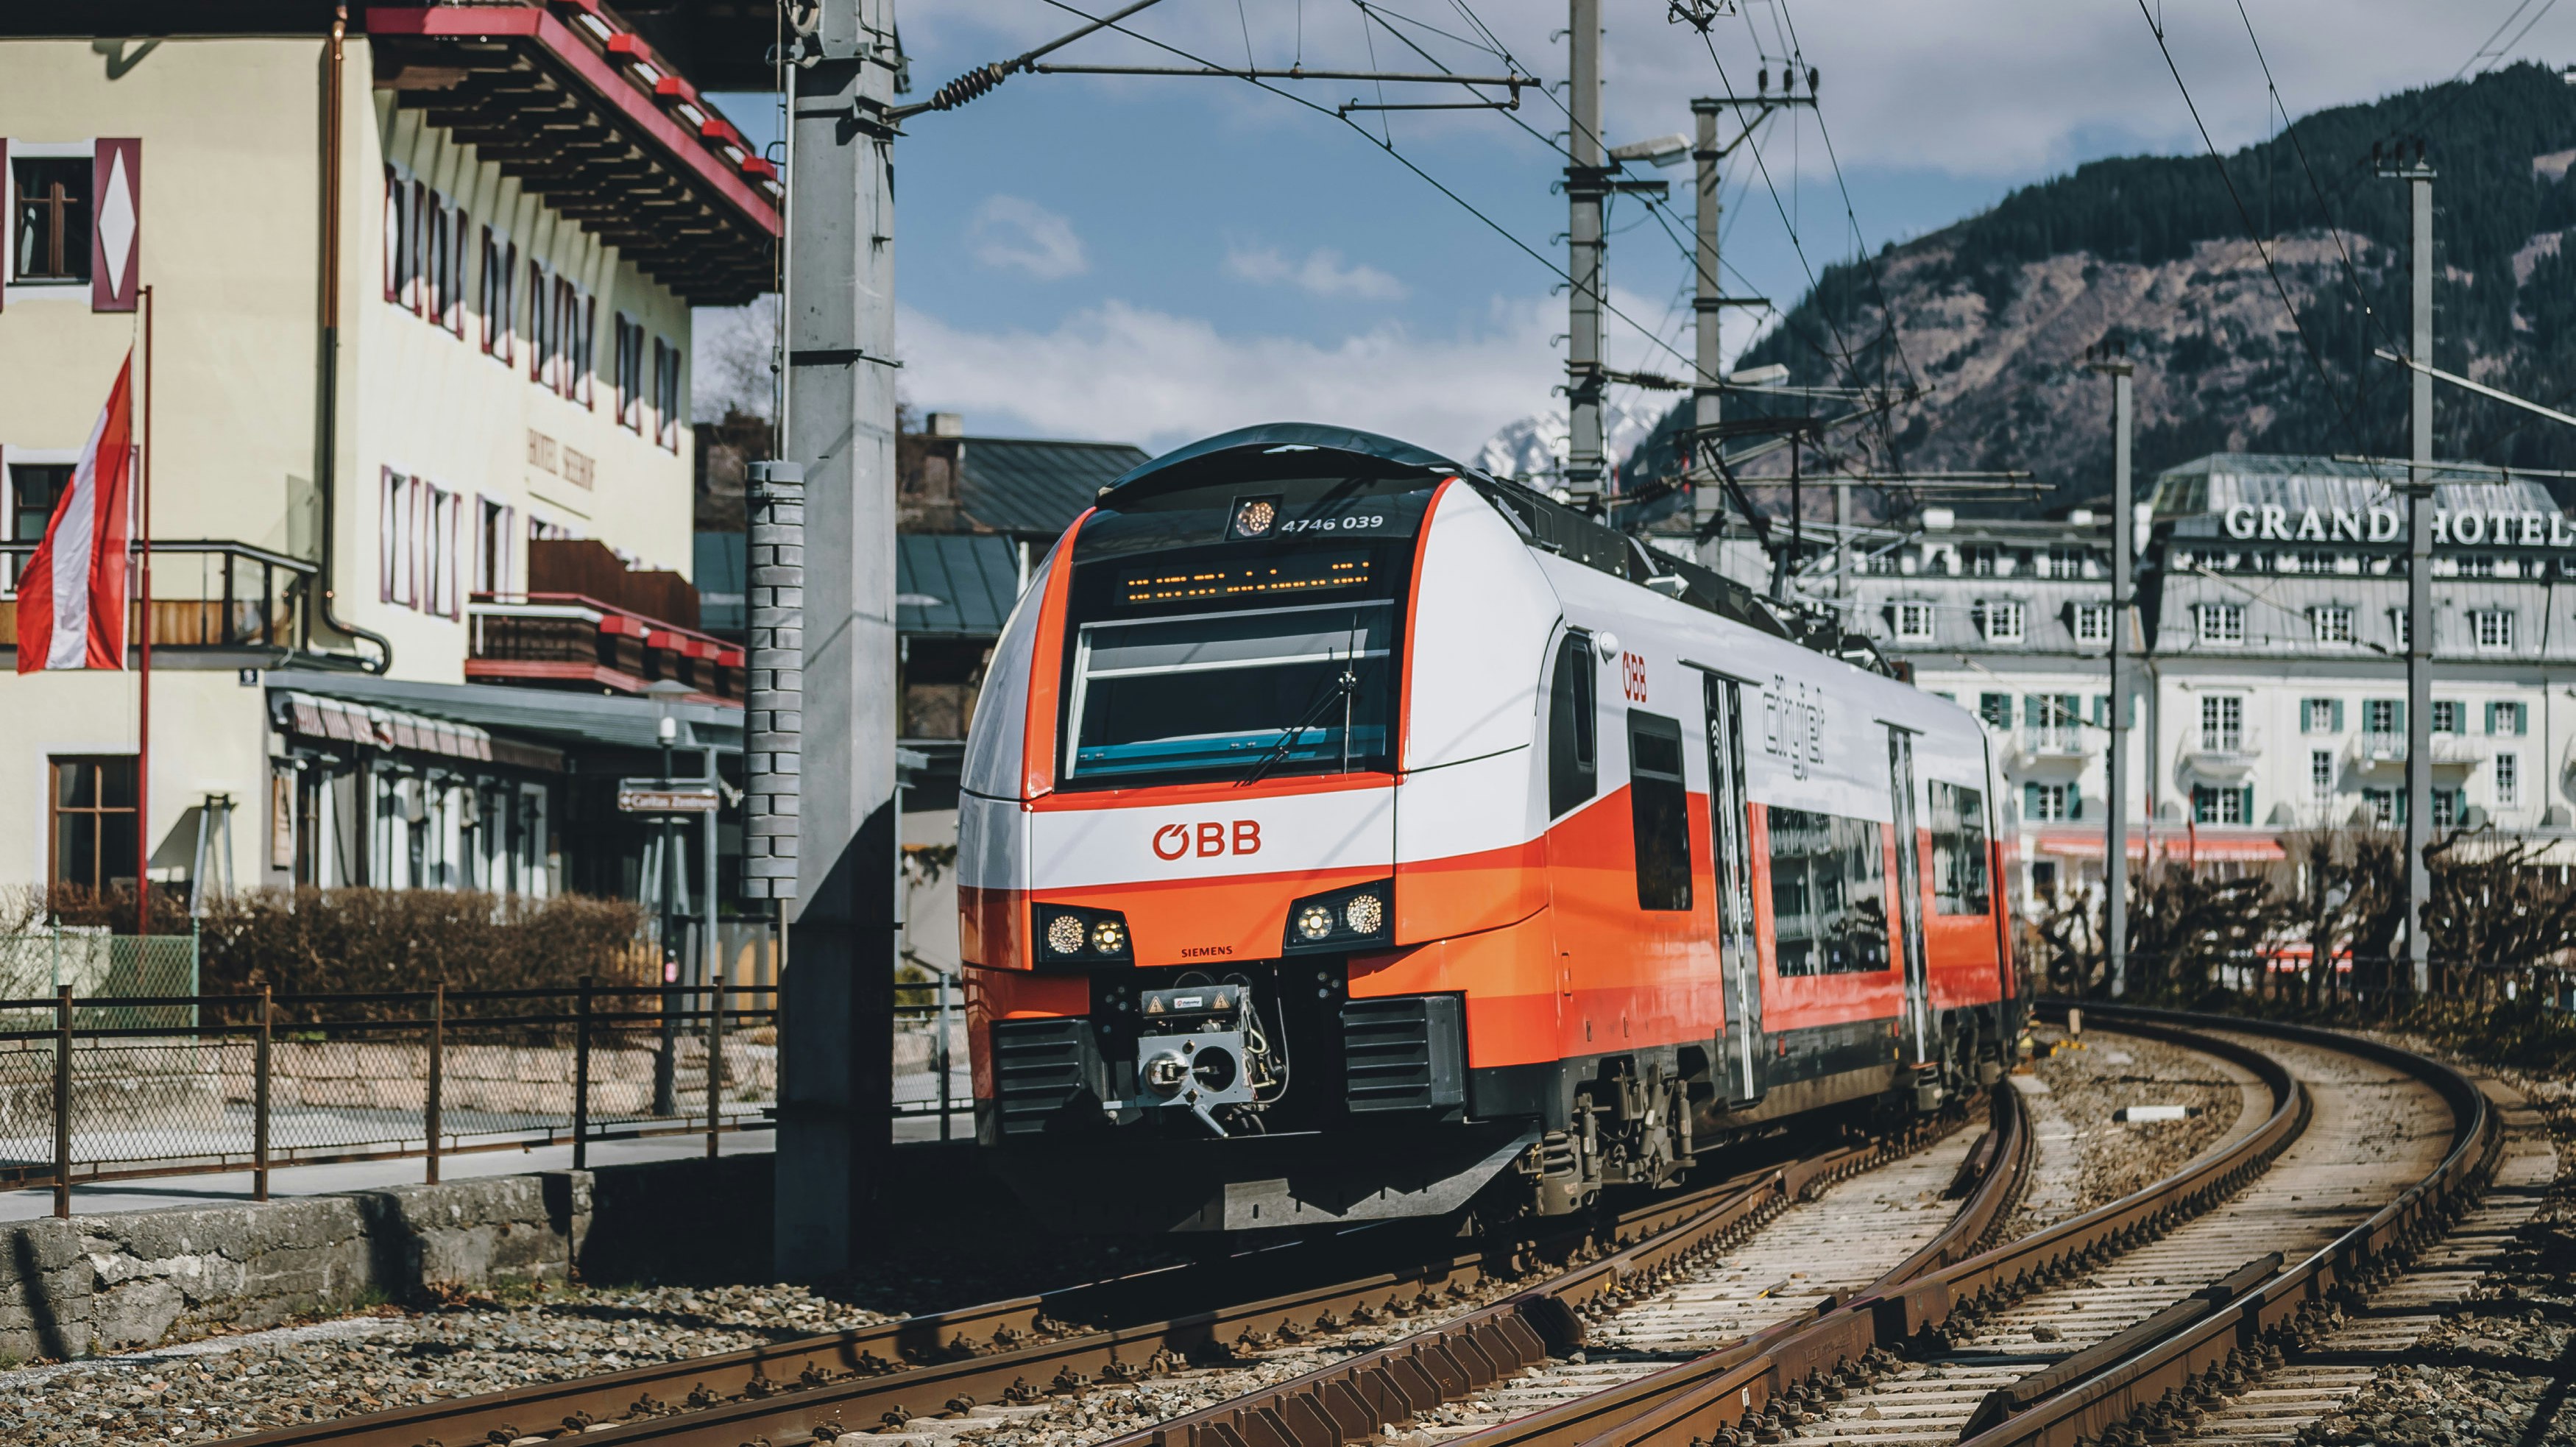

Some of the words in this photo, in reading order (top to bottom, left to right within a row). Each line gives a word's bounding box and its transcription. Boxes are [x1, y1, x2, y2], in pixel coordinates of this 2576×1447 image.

[1281, 518, 1336, 533] 4746
[1342, 516, 1384, 531] 039
[2225, 503, 2399, 542] GRAND
[1623, 651, 1646, 703] ÖBB
[1153, 819, 1262, 861] ÖBB
[1181, 945, 1233, 958] SIEMENS
